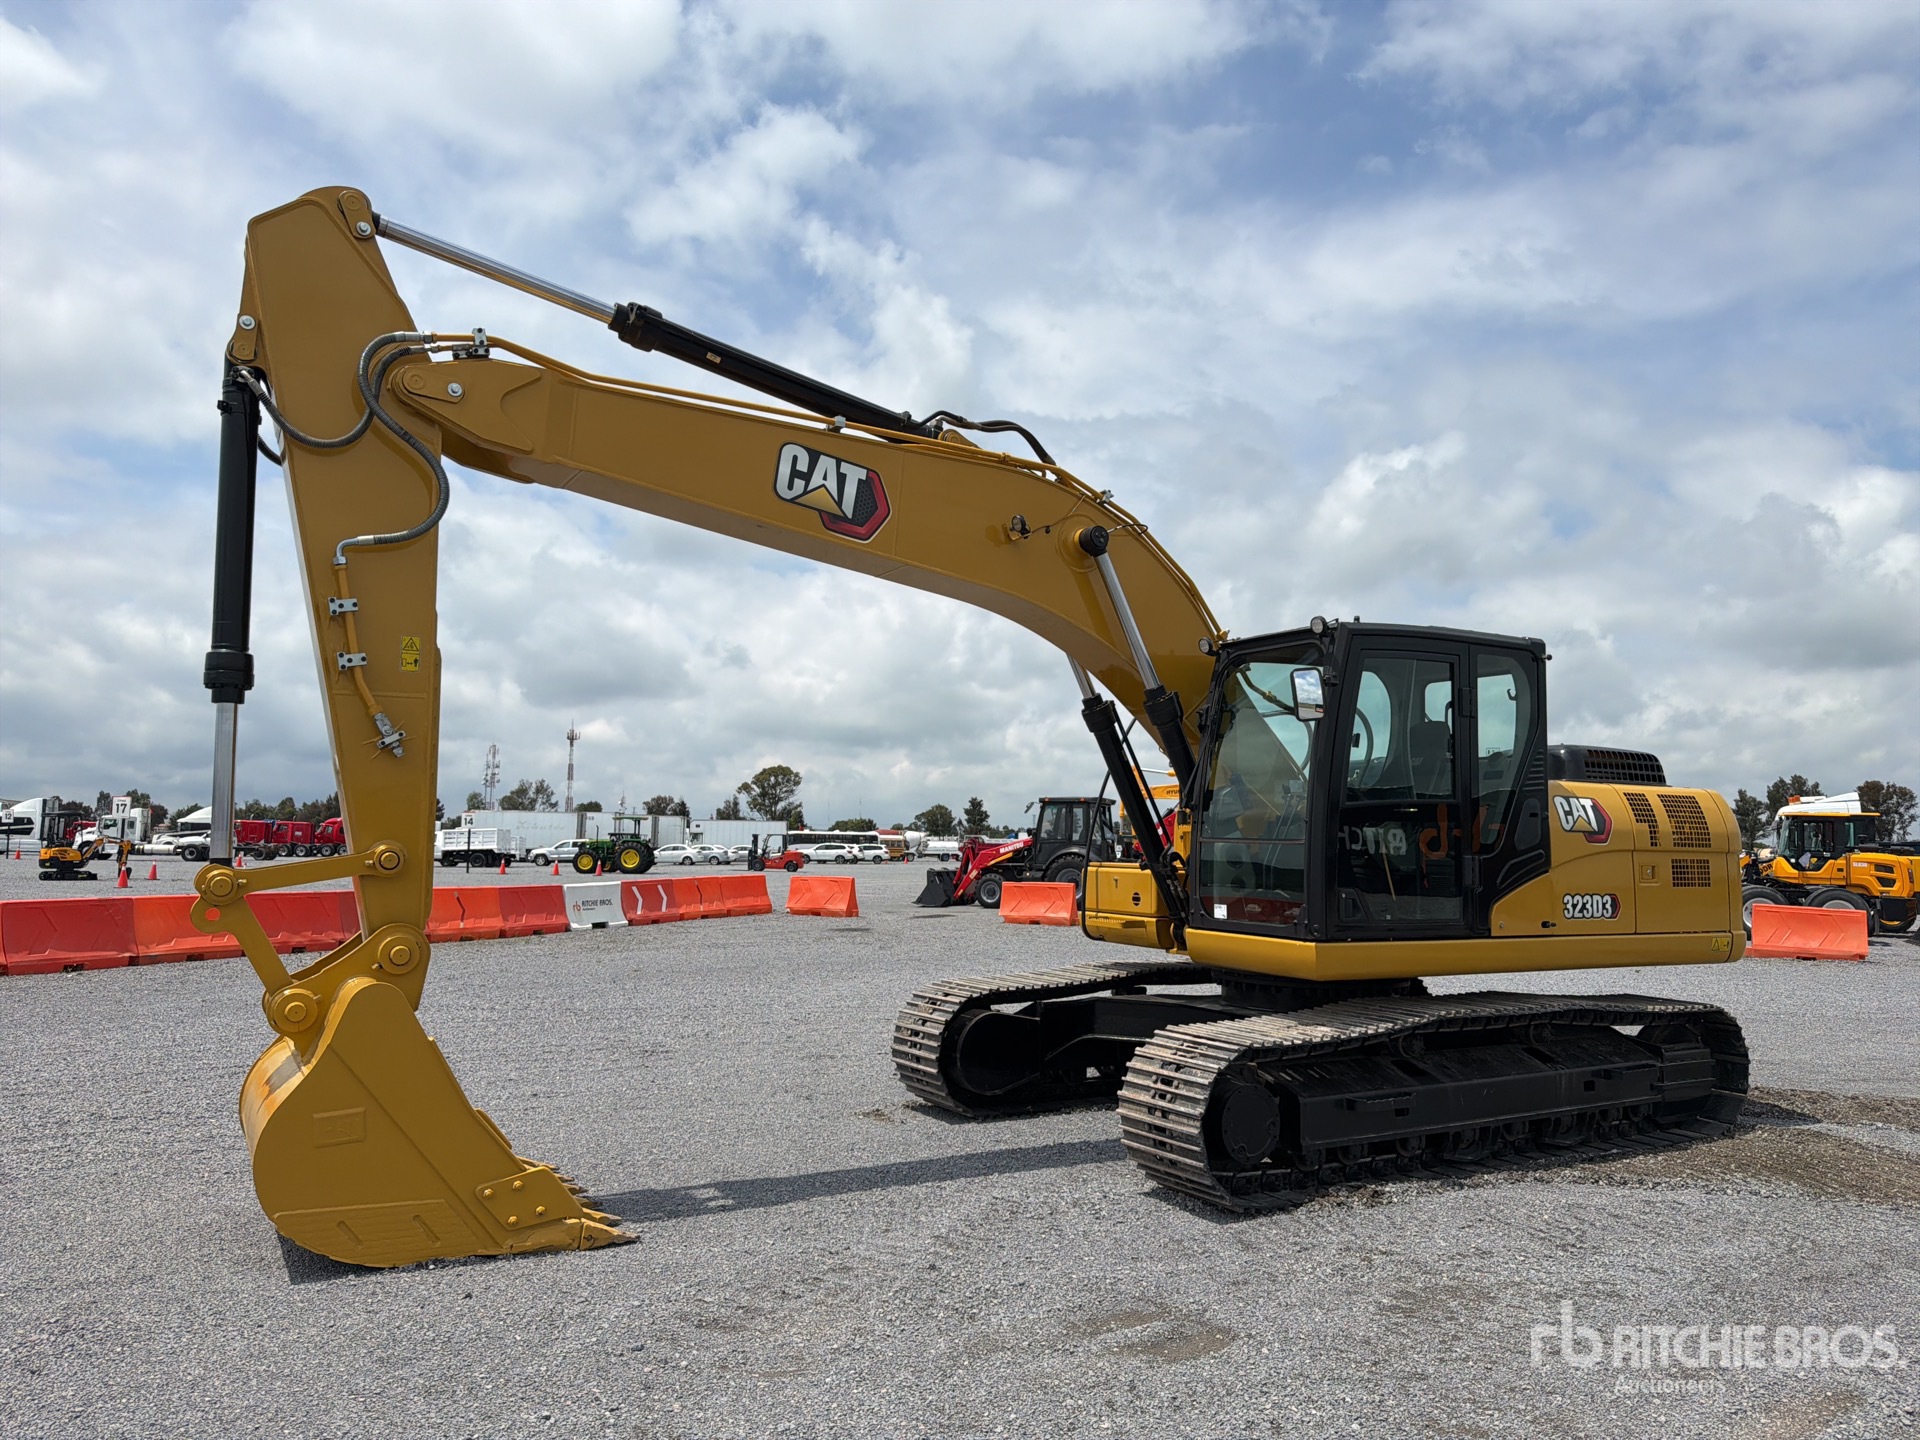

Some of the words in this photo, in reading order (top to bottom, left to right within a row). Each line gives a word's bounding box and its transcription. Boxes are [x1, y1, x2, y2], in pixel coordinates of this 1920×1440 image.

[775, 443, 867, 520] CAT
[115, 803, 127, 813] 17
[1553, 796, 1599, 832] CAT
[464, 817, 473, 825] 14
[999, 841, 1024, 854] MANITOU
[1563, 894, 1613, 919] 323D3
